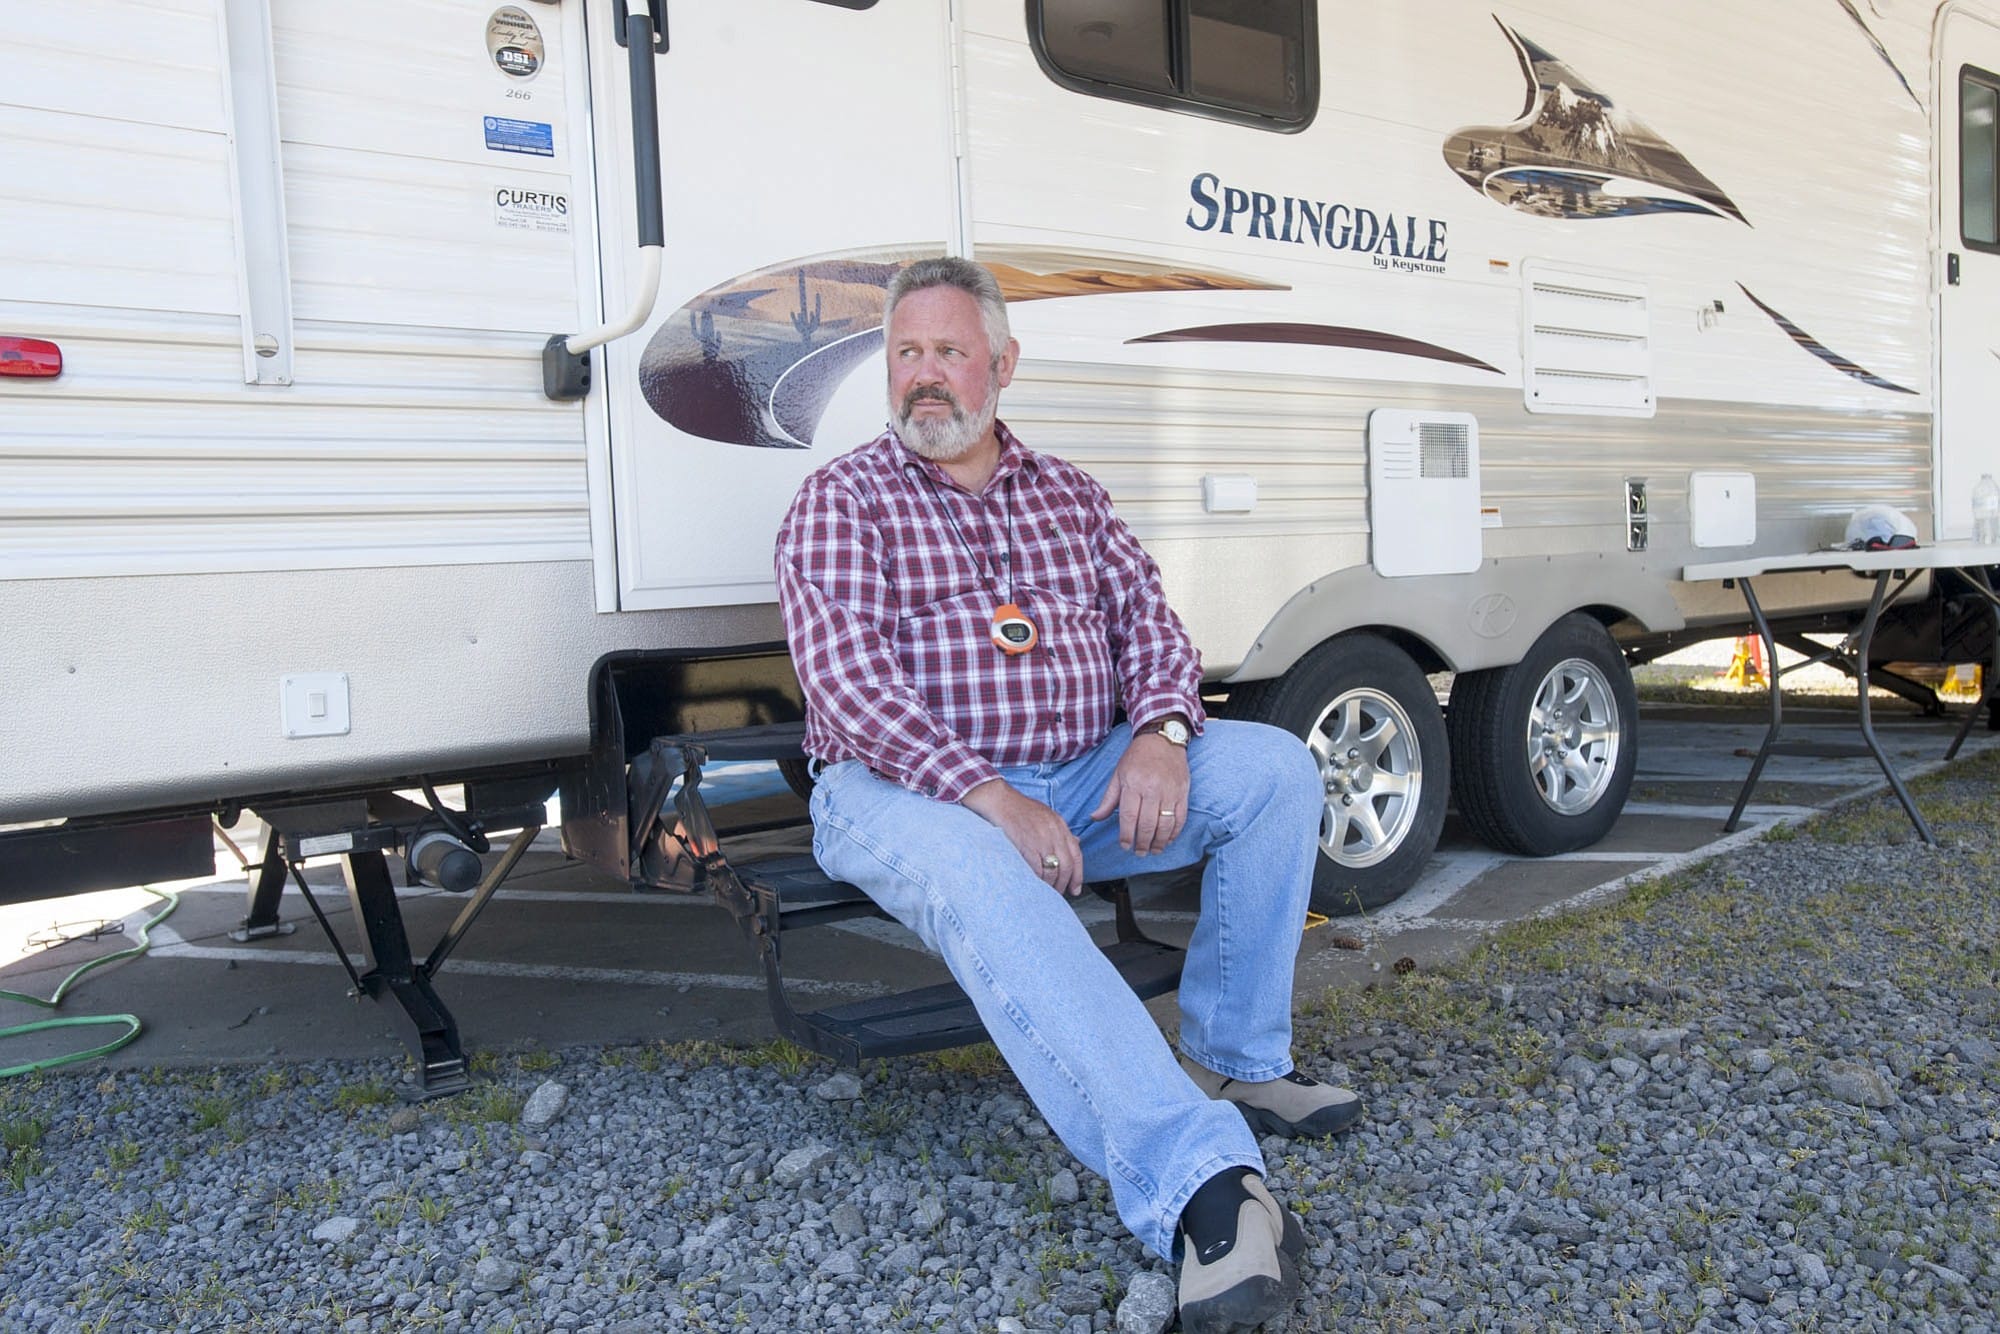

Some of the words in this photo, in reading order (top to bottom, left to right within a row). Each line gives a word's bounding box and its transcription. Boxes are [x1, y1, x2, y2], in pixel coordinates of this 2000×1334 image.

[502, 51, 529, 64] DSI
[506, 89, 532, 100] 266
[497, 189, 567, 215] CURTIS
[1186, 172, 1448, 263] SPRINGDALE
[1373, 255, 1388, 270] by
[1392, 258, 1446, 274] Keystone
